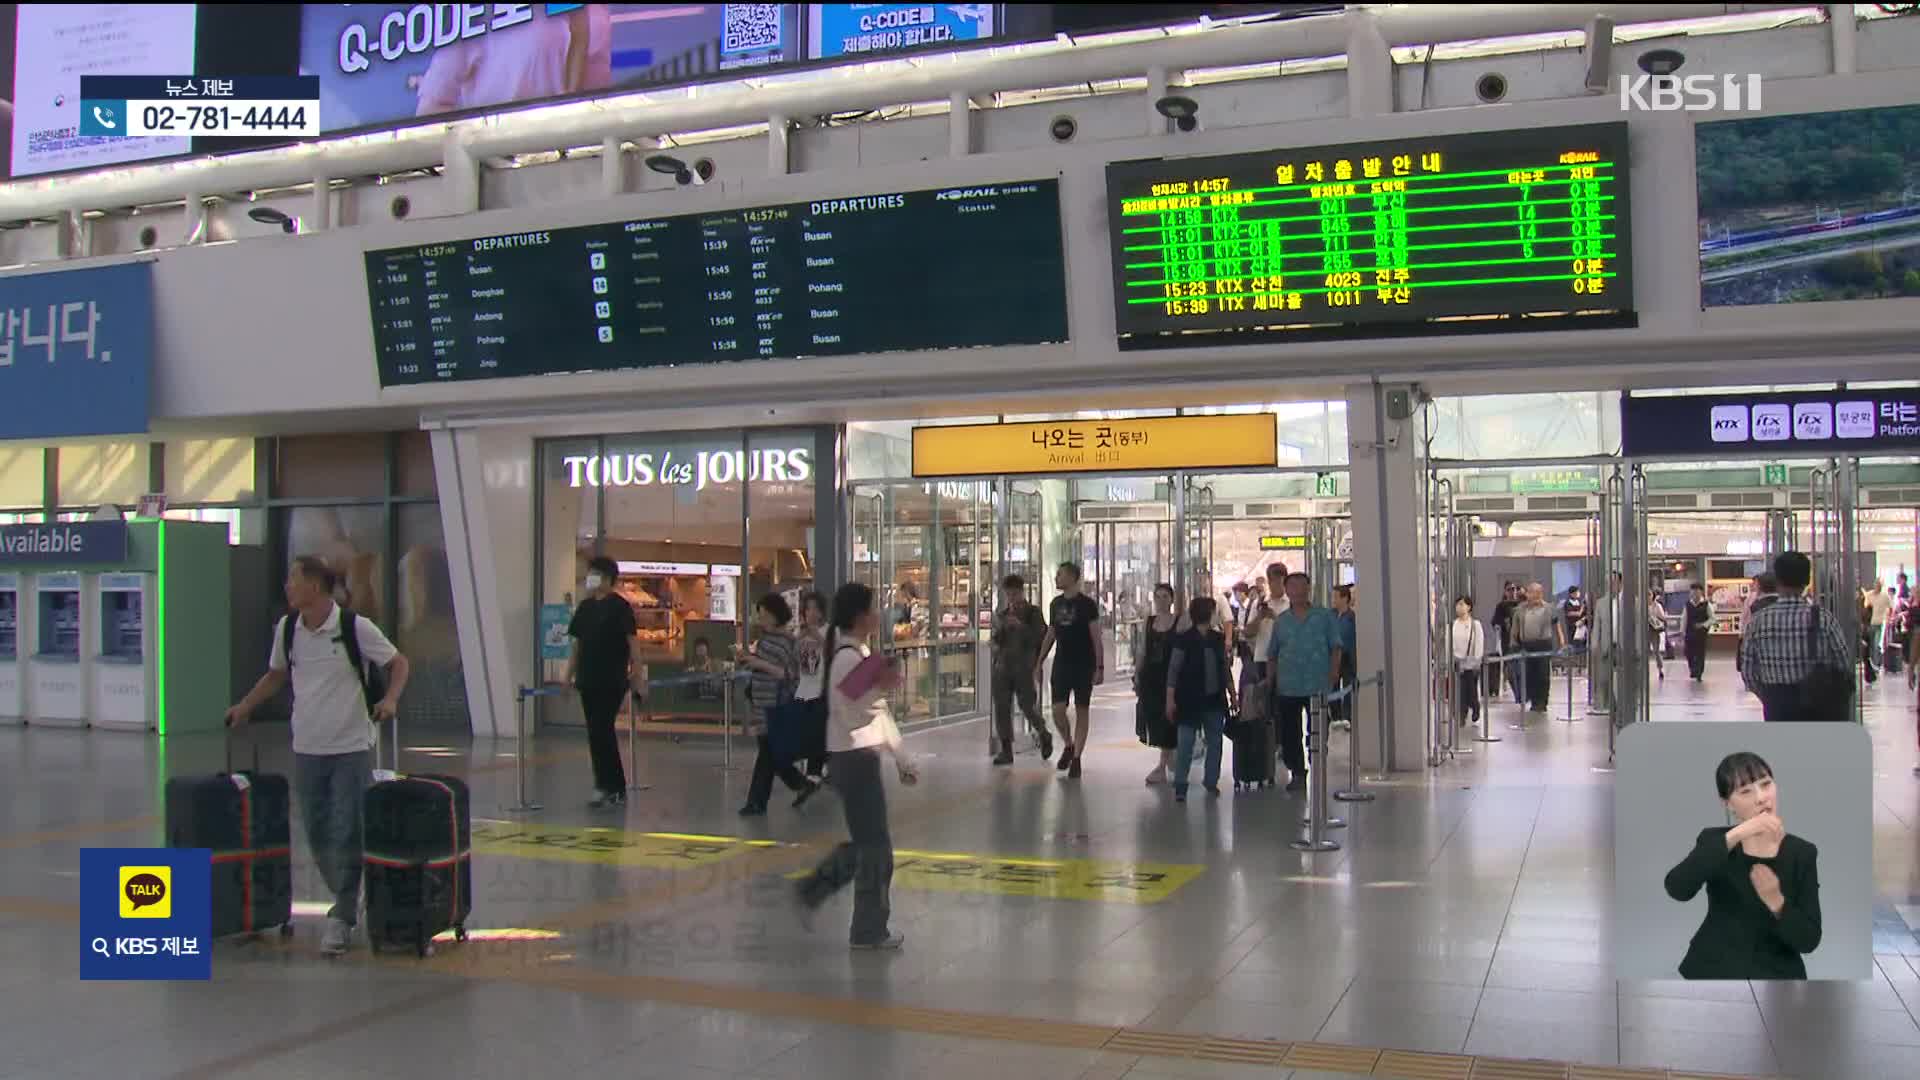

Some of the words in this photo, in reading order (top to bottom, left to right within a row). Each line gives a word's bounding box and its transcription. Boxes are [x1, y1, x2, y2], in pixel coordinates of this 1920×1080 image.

[1192, 178, 1230, 194] 14:57
[811, 194, 905, 216] DEPARTURES
[473, 232, 551, 252] DEPARTURES
[704, 240, 728, 251] 15:39
[804, 232, 832, 242] Busan
[705, 265, 730, 276] 15:45
[806, 257, 834, 267] Busan
[808, 283, 843, 293] Pohang
[1165, 281, 1207, 298] 15:23
[1215, 278, 1244, 294] KTX
[1325, 271, 1361, 288] 4023
[1376, 268, 1410, 286] 진주
[1166, 298, 1208, 316] 15:39
[1218, 296, 1244, 312] ITX
[1327, 290, 1361, 307] 1011
[1377, 286, 1410, 305] 부산
[810, 309, 839, 318] Busan
[813, 335, 841, 344] Busan
[1880, 402, 1918, 422] 타는
[1714, 418, 1740, 430] KTX
[1032, 428, 1085, 449] 나오는
[1048, 452, 1084, 464] Arrival
[563, 454, 654, 487] TOUS
[659, 451, 692, 484] les
[695, 447, 810, 491] JOURS
